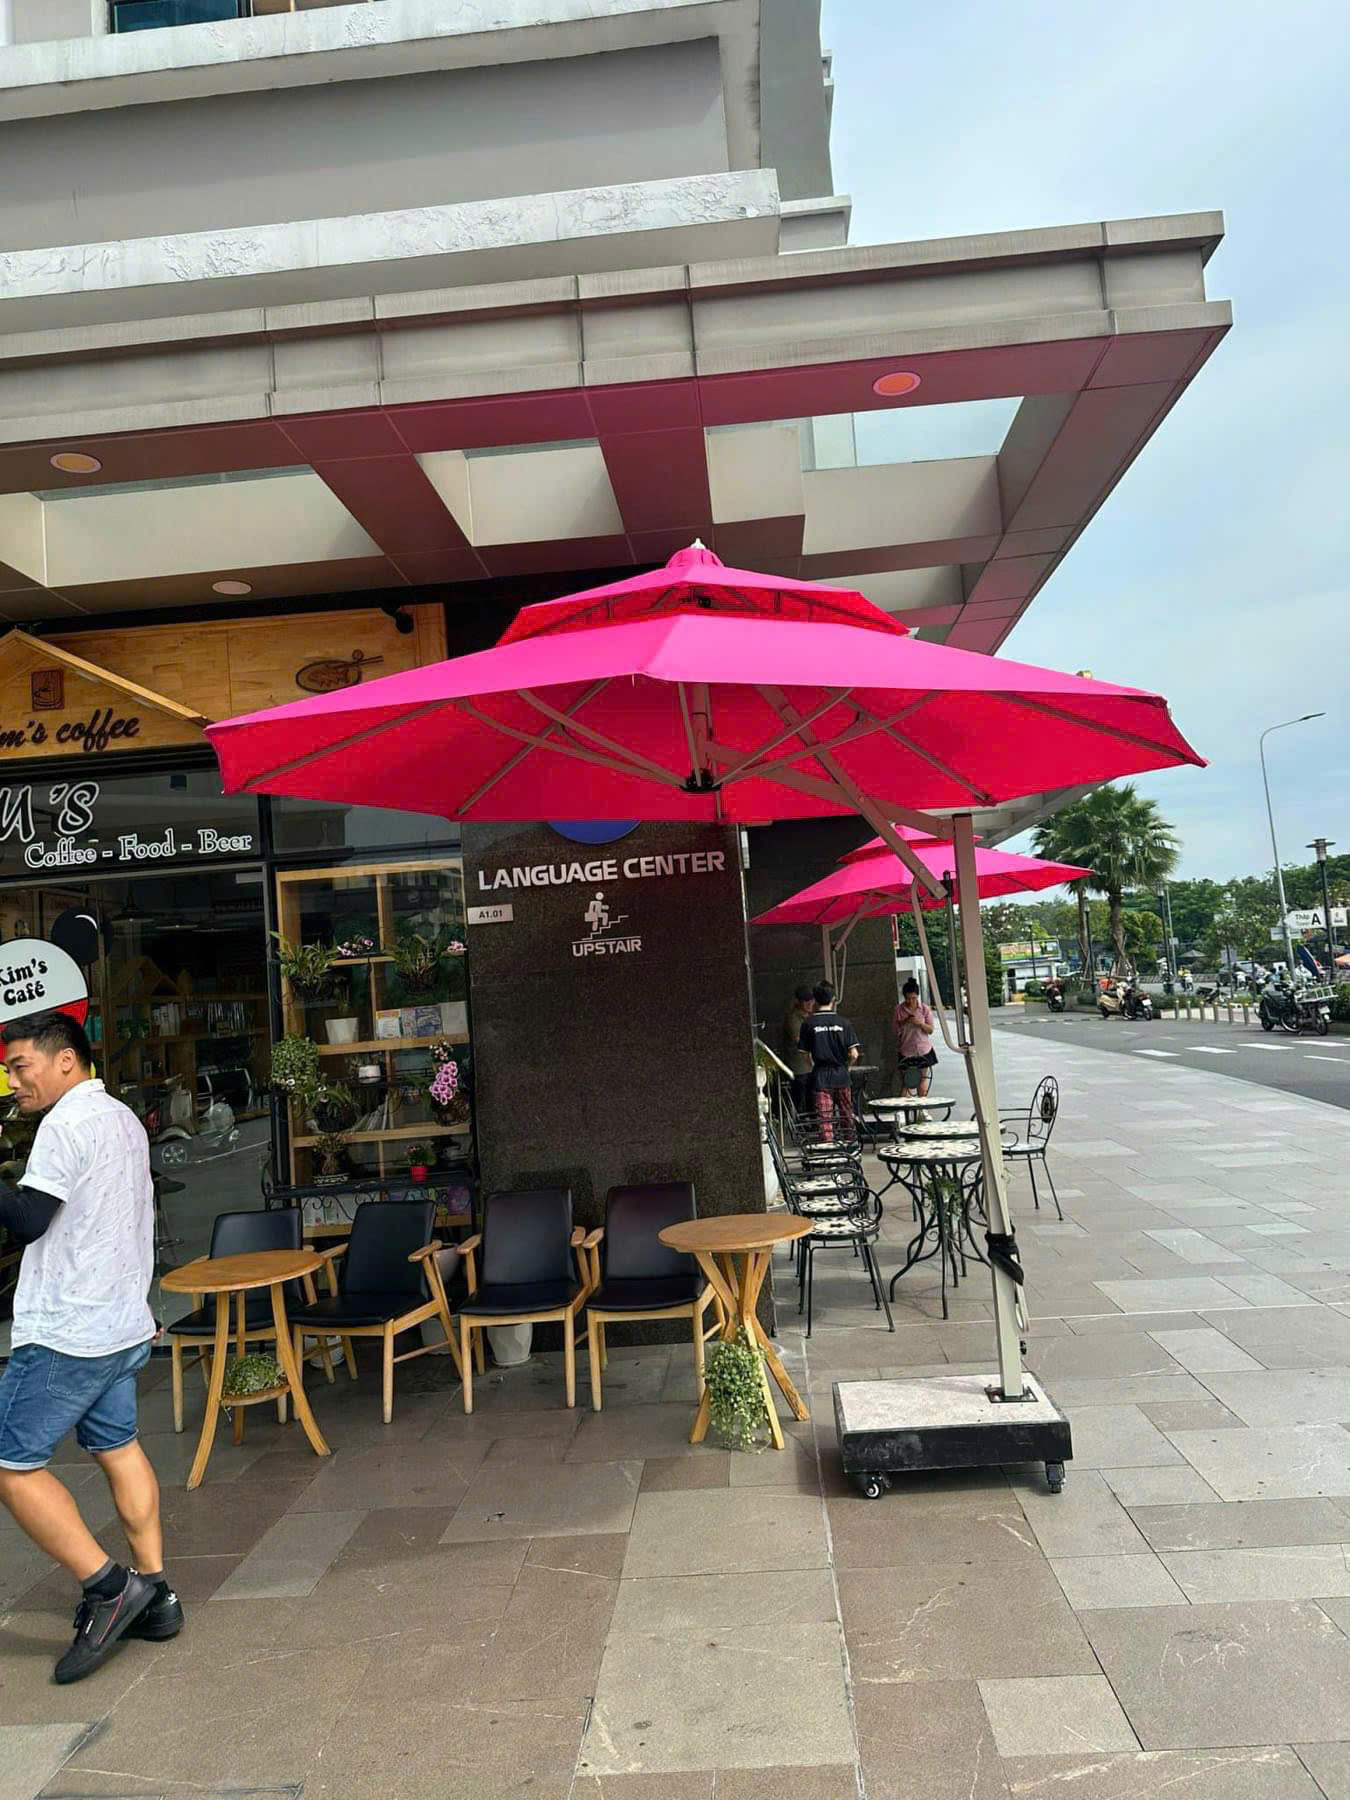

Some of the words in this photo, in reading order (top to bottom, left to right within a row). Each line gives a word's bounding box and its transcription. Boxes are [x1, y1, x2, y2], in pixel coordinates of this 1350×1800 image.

[56, 708, 140, 752] coffee
[25, 836, 97, 868] Coffee
[118, 828, 176, 860] Food
[198, 828, 252, 854] Beer
[478, 859, 618, 890] LANGUAGE
[623, 851, 726, 879] CENTER
[478, 909, 503, 920] A1.01
[1312, 912, 1321, 925] A
[572, 938, 642, 957] UPSTAIR
[3, 980, 46, 1006] Café
